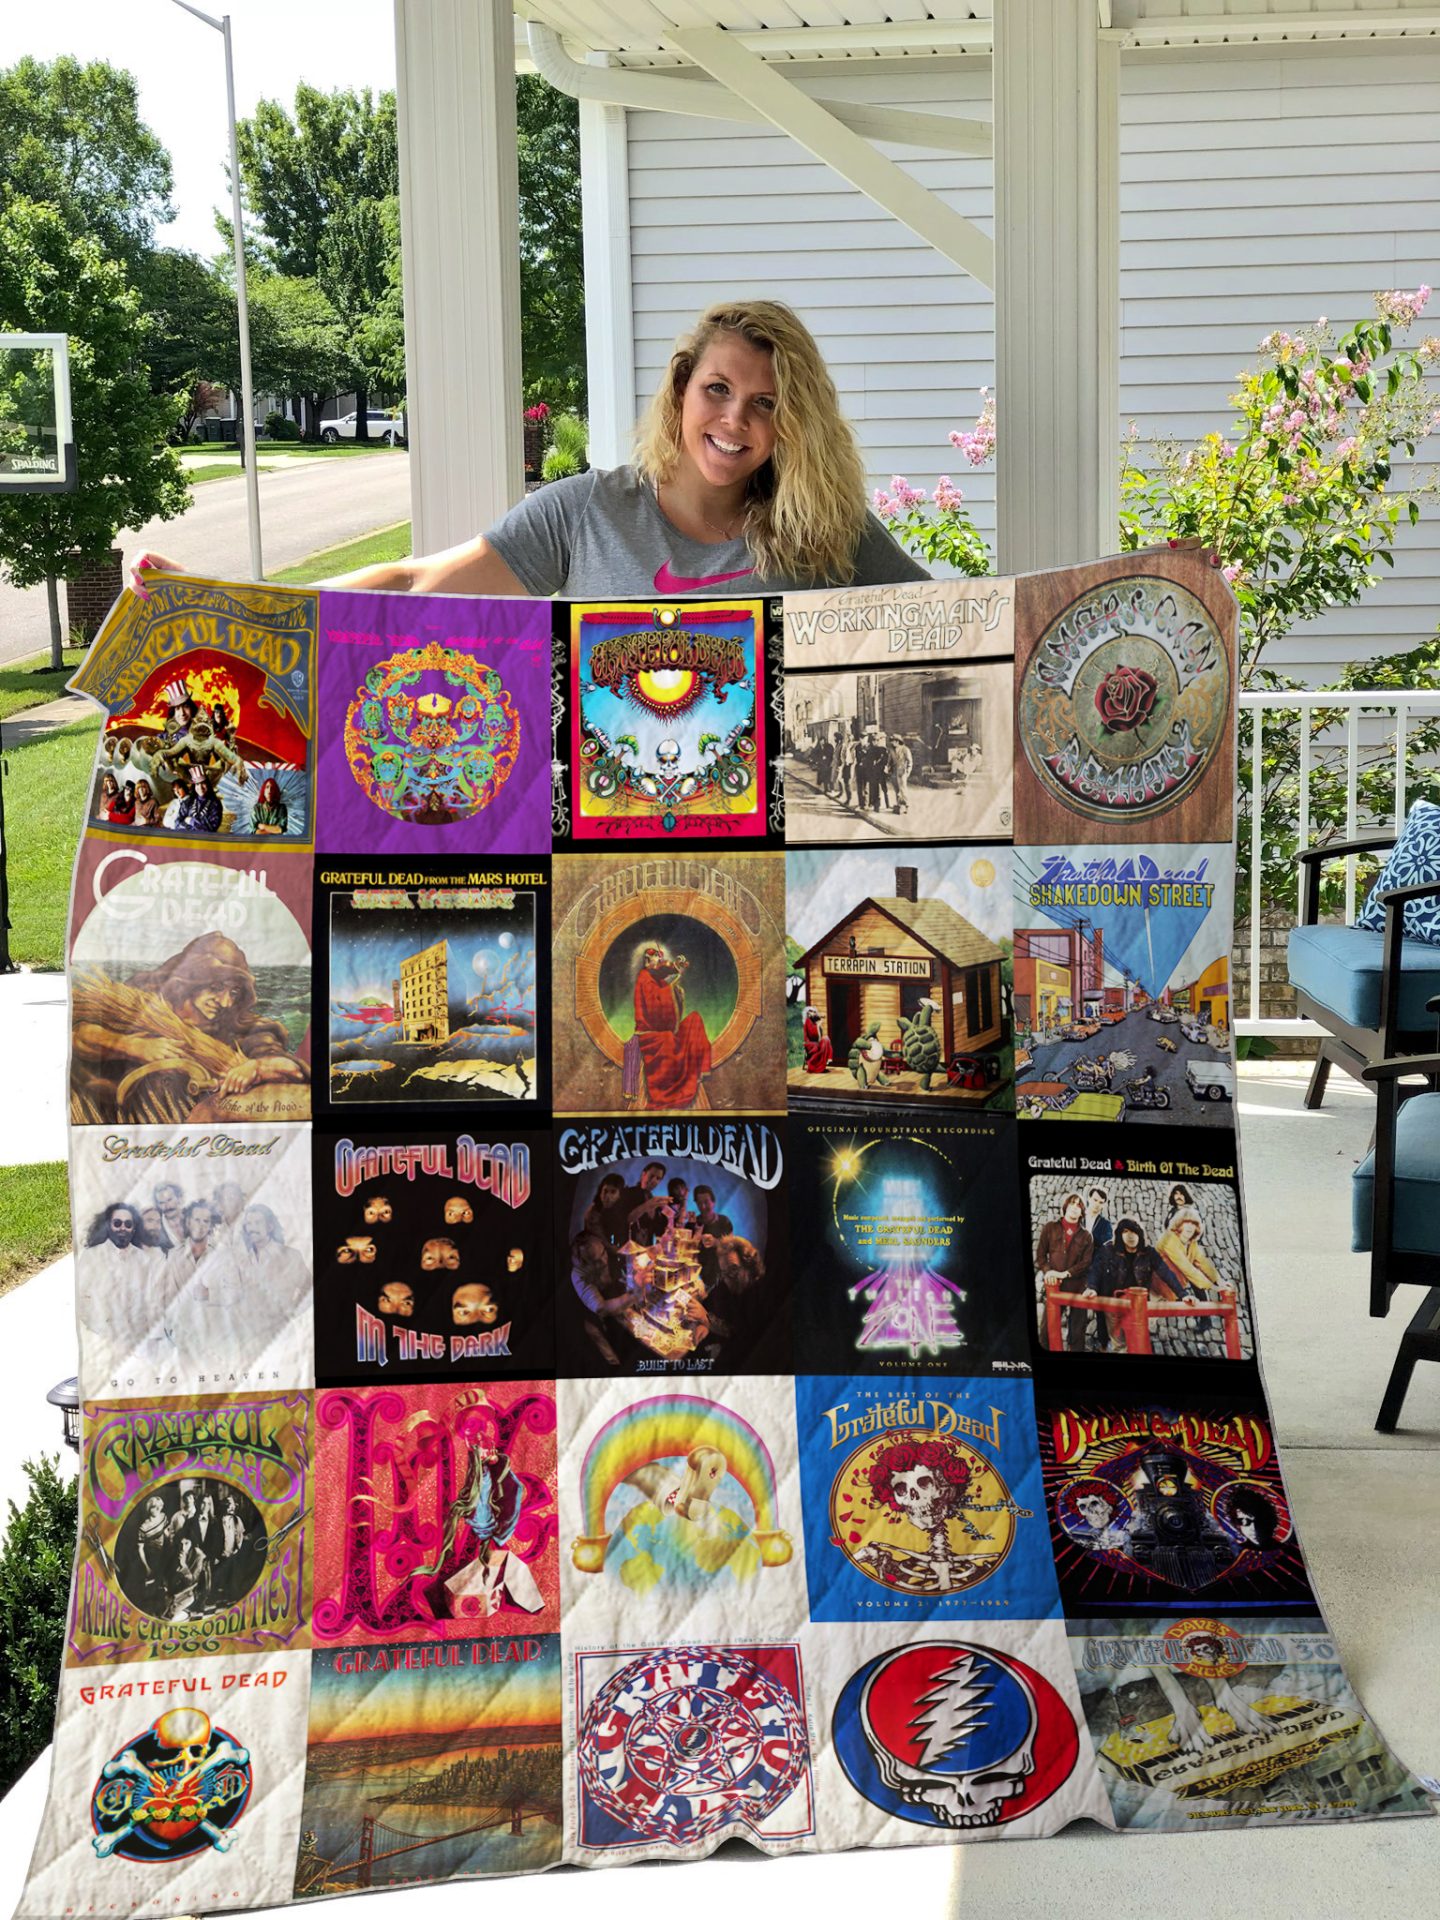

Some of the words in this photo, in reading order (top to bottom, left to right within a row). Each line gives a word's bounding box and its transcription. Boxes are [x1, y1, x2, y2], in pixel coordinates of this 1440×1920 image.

[12, 459, 57, 471] SPALDING
[889, 625, 963, 653] DEAD
[106, 615, 225, 704] GRATEFUL
[228, 623, 300, 676] DEAD
[320, 871, 386, 886] GRATEFUL
[388, 872, 424, 886] DEAD
[424, 876, 448, 886] FROM
[450, 876, 467, 886] THE
[467, 872, 503, 885] MARS
[505, 872, 547, 885] HOTEL
[1131, 854, 1209, 883] Dead
[92, 849, 277, 920] GRATEFUL
[1029, 883, 1142, 907] SHAKEDOWN
[1148, 884, 1215, 908] STREET
[161, 899, 248, 928] DEAD
[827, 957, 876, 973] TERRAPIN
[884, 959, 927, 975] STATION
[863, 1126, 932, 1134] SOUNDTRACK
[937, 1127, 996, 1135] RECORDING
[102, 1135, 210, 1162] Grateful
[206, 1134, 281, 1158] Dead
[334, 1138, 453, 1198] GRATEFUL
[456, 1134, 531, 1210] DEAD
[1028, 1155, 1077, 1169] Grateful
[1080, 1157, 1112, 1171] Dead
[1126, 1159, 1157, 1173] Birth
[1160, 1161, 1174, 1174] Of
[1176, 1162, 1200, 1176] The
[1203, 1164, 1234, 1178] Dead
[854, 1224, 874, 1233] THE
[877, 1224, 926, 1234] GRATEFUL
[928, 1225, 954, 1234] DEAD
[957, 1216, 965, 1224] by
[858, 1237, 872, 1245] and
[392, 1324, 446, 1361] THE
[450, 1320, 513, 1363] DARK
[856, 1301, 965, 1358] ZONE
[686, 1358, 715, 1371] LAST
[111, 1378, 135, 1388] GO
[155, 1375, 177, 1384] TO
[199, 1371, 279, 1383] HEAVEN
[856, 1391, 879, 1399] THE
[888, 1391, 916, 1399] BEST
[925, 1391, 940, 1399] OF
[948, 1391, 971, 1399] THE
[822, 1399, 926, 1450] Grateful
[927, 1400, 1008, 1452] Dead
[1052, 1408, 1148, 1464] DYLAN
[1182, 1413, 1272, 1471] DEAD
[88, 1407, 283, 1521] GRATEFUL
[141, 1440, 300, 1505] DEAD
[80, 1560, 131, 1641] RARE
[1168, 1621, 1229, 1638] DAVE'S
[148, 1637, 221, 1658] 1966
[333, 1648, 465, 1675] GRATEFUL
[471, 1639, 543, 1666] DEAD
[1297, 1643, 1335, 1661] 30
[1186, 1663, 1237, 1678] PICKS
[79, 1677, 212, 1705] GRATEFUL
[222, 1671, 288, 1689] DEAD
